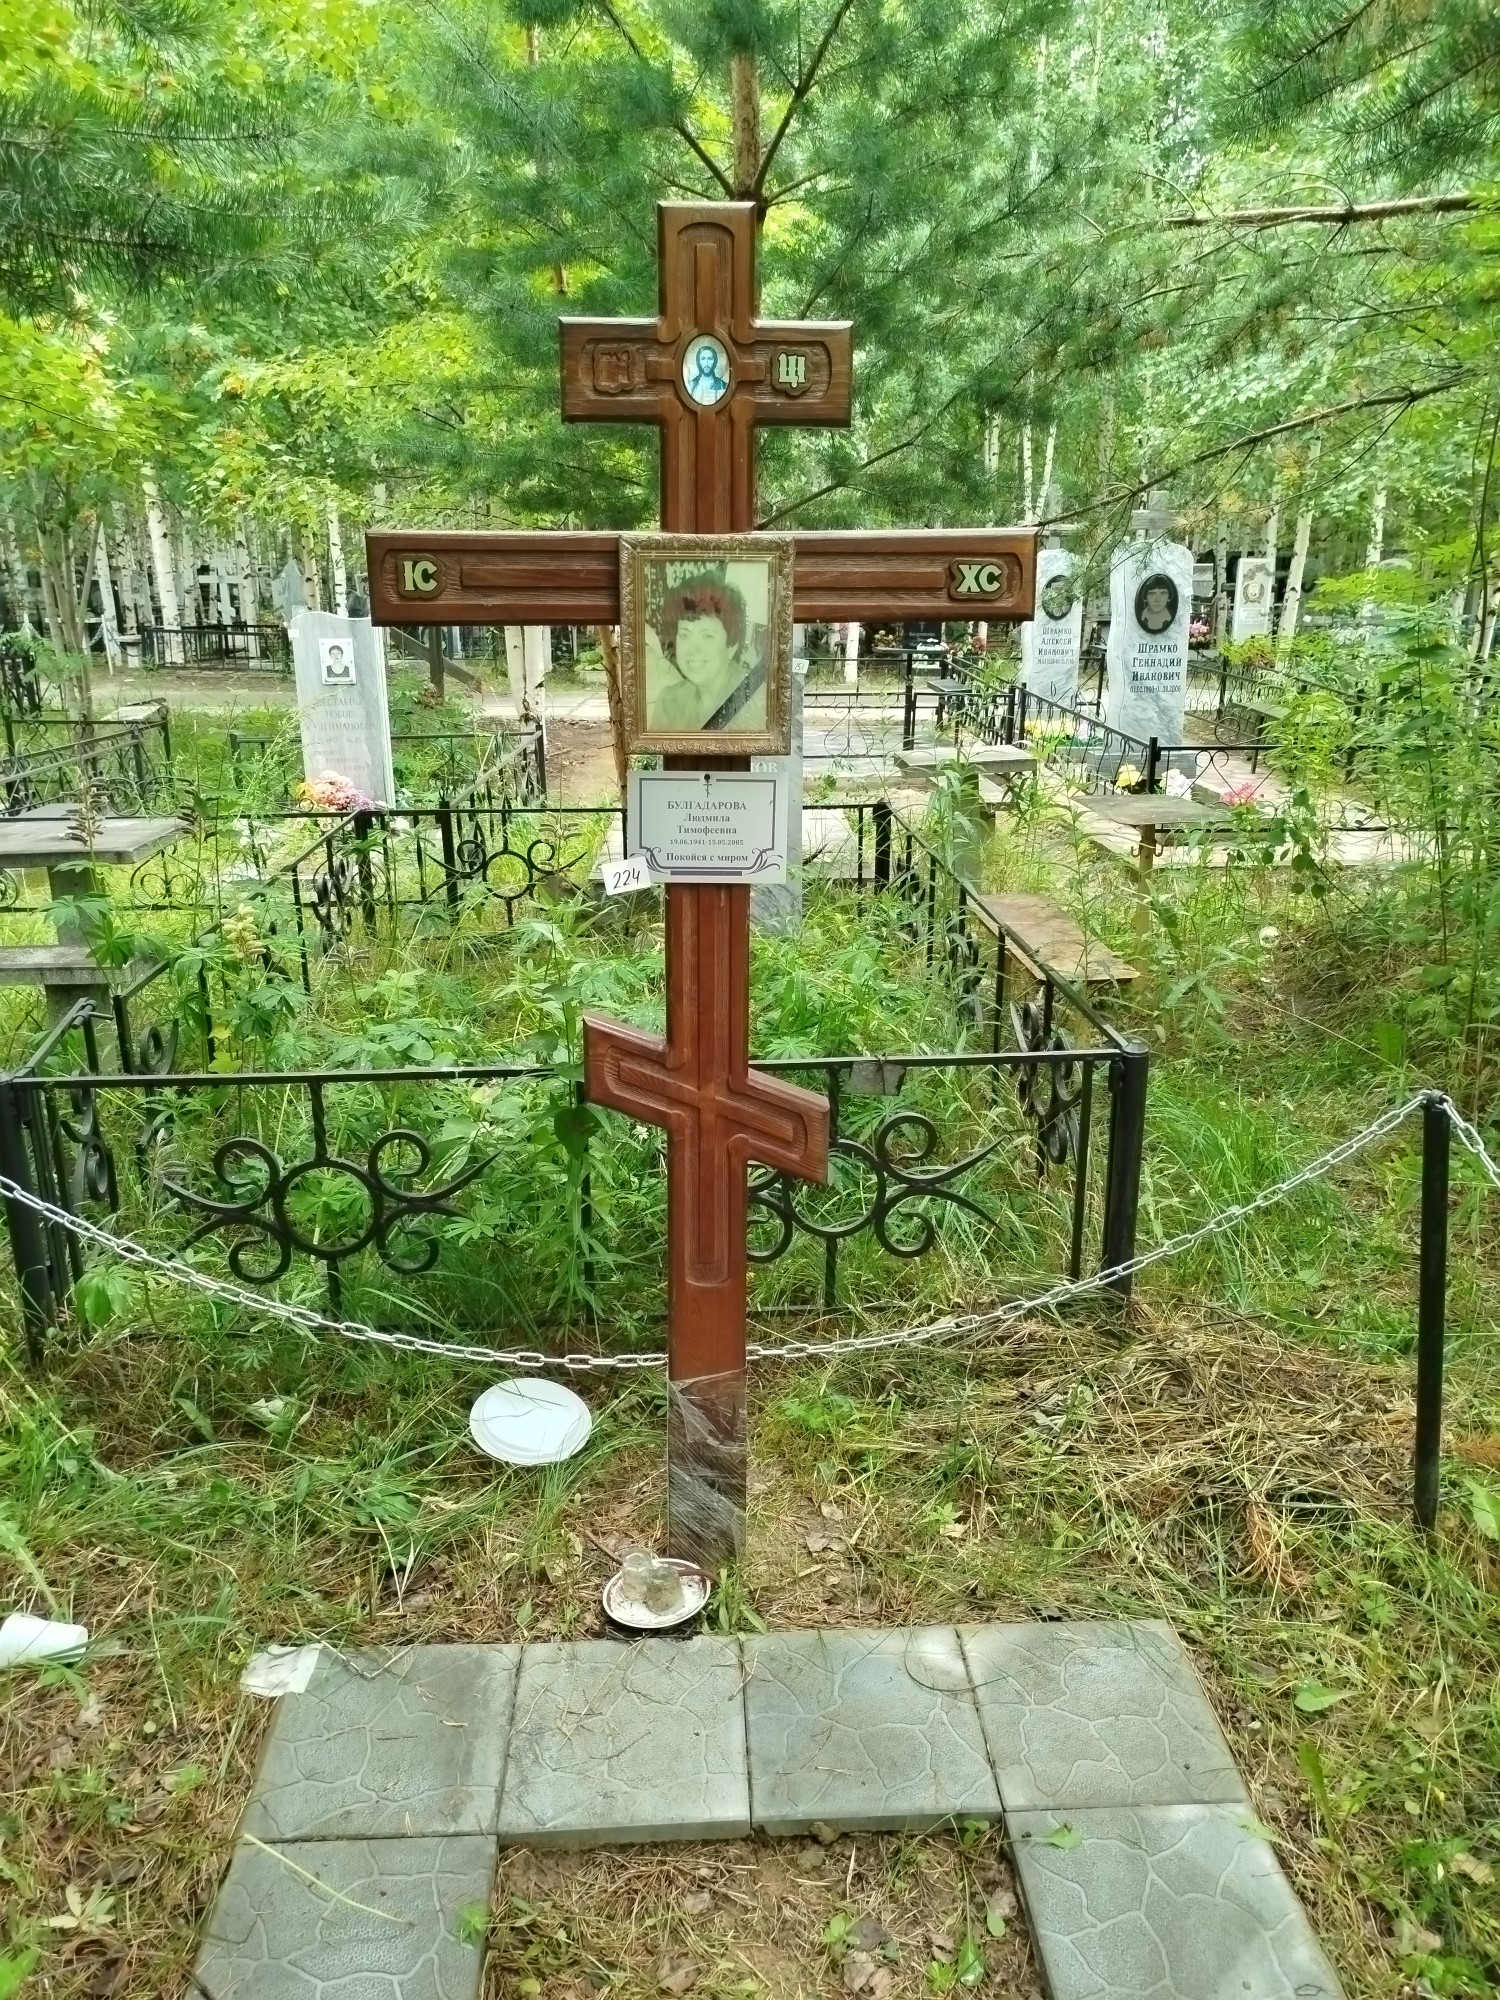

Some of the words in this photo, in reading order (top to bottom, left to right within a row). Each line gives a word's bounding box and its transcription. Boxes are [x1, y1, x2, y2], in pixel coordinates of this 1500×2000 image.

[1138, 643, 1178, 654] ШРАМКО
[1132, 657, 1182, 669] ГЕННАДИЙ
[1132, 671, 1181, 682] ИВАНОВИЧ
[667, 801, 747, 811] БУЛГАДАРОВА
[684, 813, 730, 822] Людмила
[677, 825, 737, 836] Тимофеевна
[666, 852, 707, 862] Покойся
[717, 855, 748, 864] миром
[613, 868, 640, 890] 224
